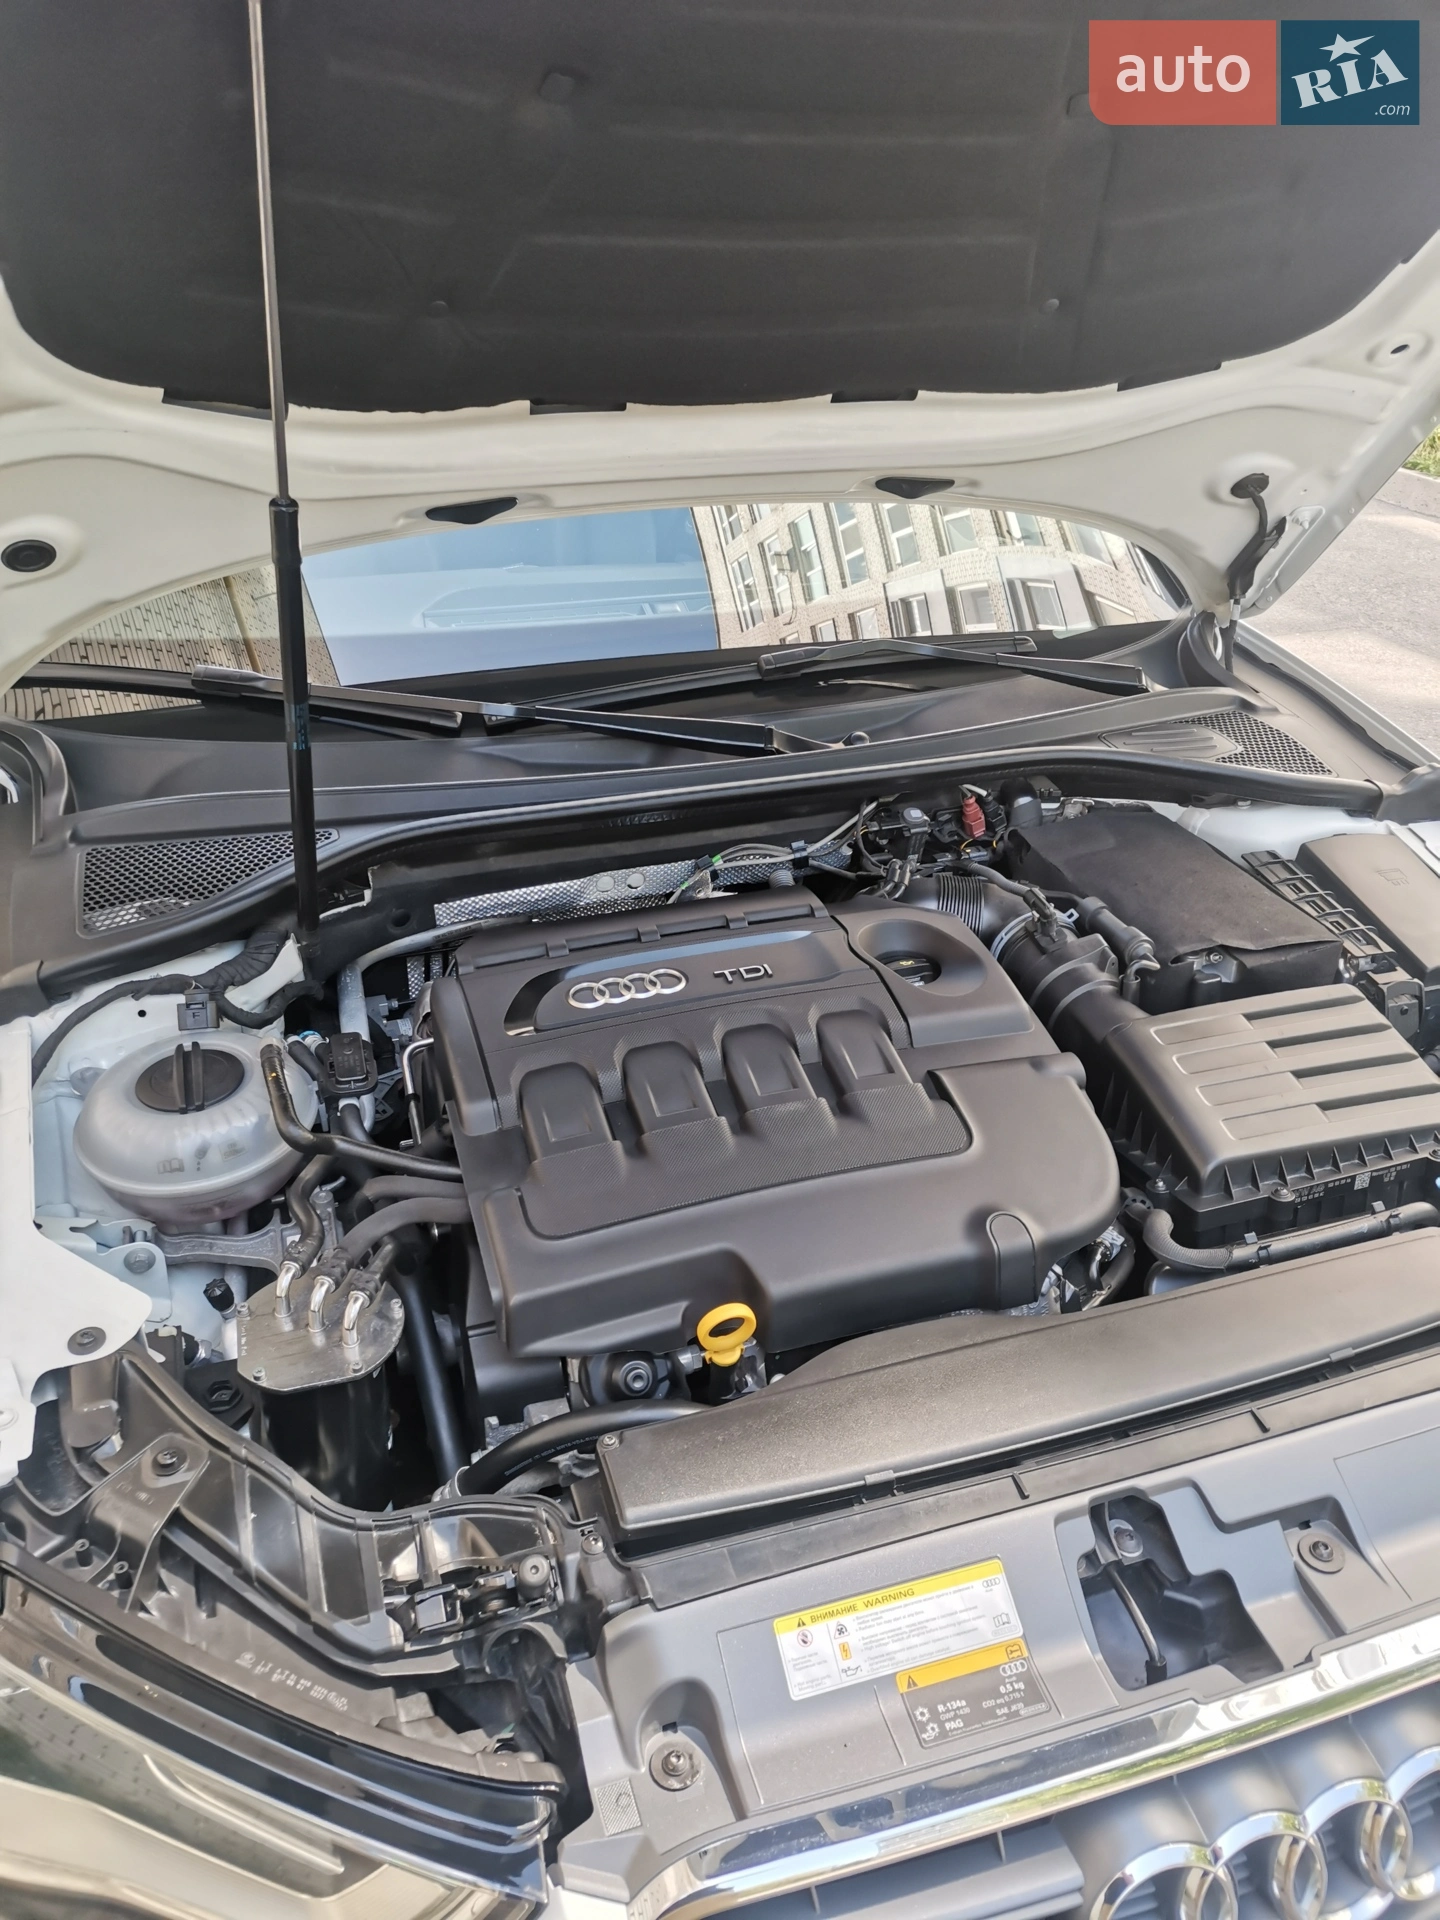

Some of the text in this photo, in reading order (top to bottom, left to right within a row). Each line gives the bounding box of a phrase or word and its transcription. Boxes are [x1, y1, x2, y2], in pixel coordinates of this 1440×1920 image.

[713, 963, 774, 985] TDI
[810, 1603, 859, 1625] ВНИМАНИЕ
[863, 1588, 915, 1608] WARNING
[1000, 1681, 1025, 1694] 0,5 kg
[937, 1699, 967, 1713] R-134a
[982, 1699, 996, 1708] CO2
[940, 1711, 955, 1721] GWP
[996, 1706, 1009, 1716] SAE
[945, 1719, 964, 1731] PAG
